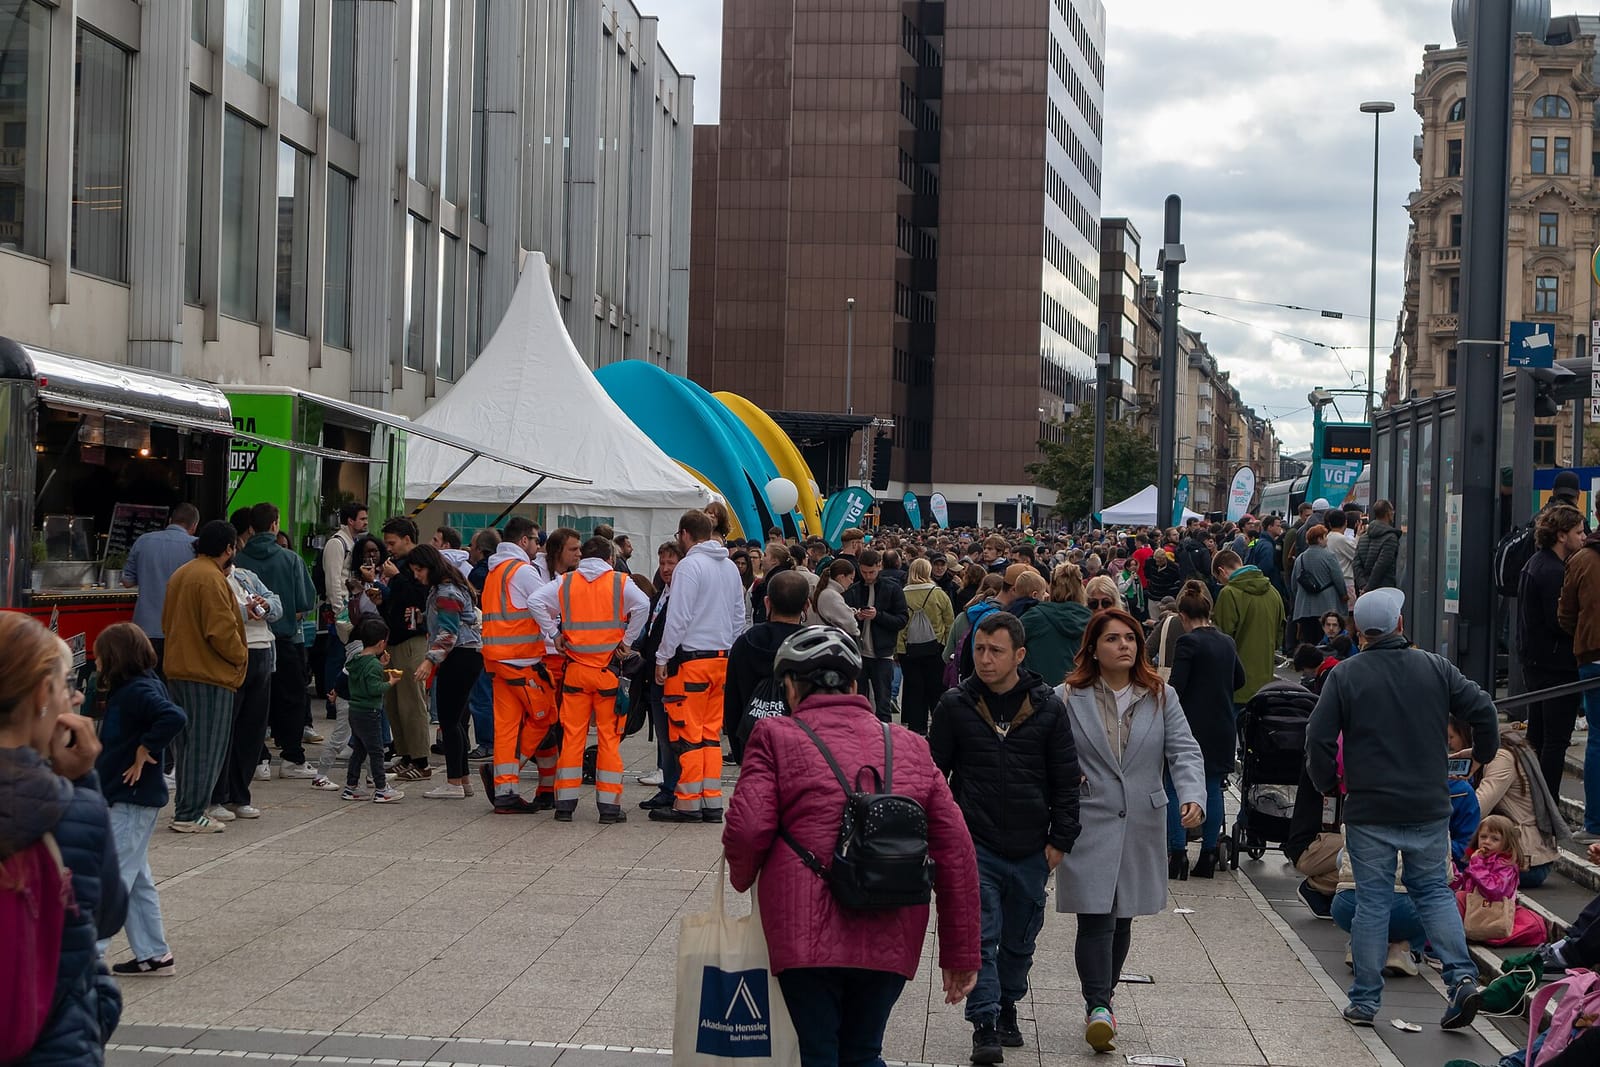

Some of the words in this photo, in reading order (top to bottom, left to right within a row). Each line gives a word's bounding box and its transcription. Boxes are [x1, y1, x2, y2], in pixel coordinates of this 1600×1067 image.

[1324, 461, 1358, 484] VGF
[846, 493, 864, 524] VGF
[735, 1022, 767, 1033] Henssler
